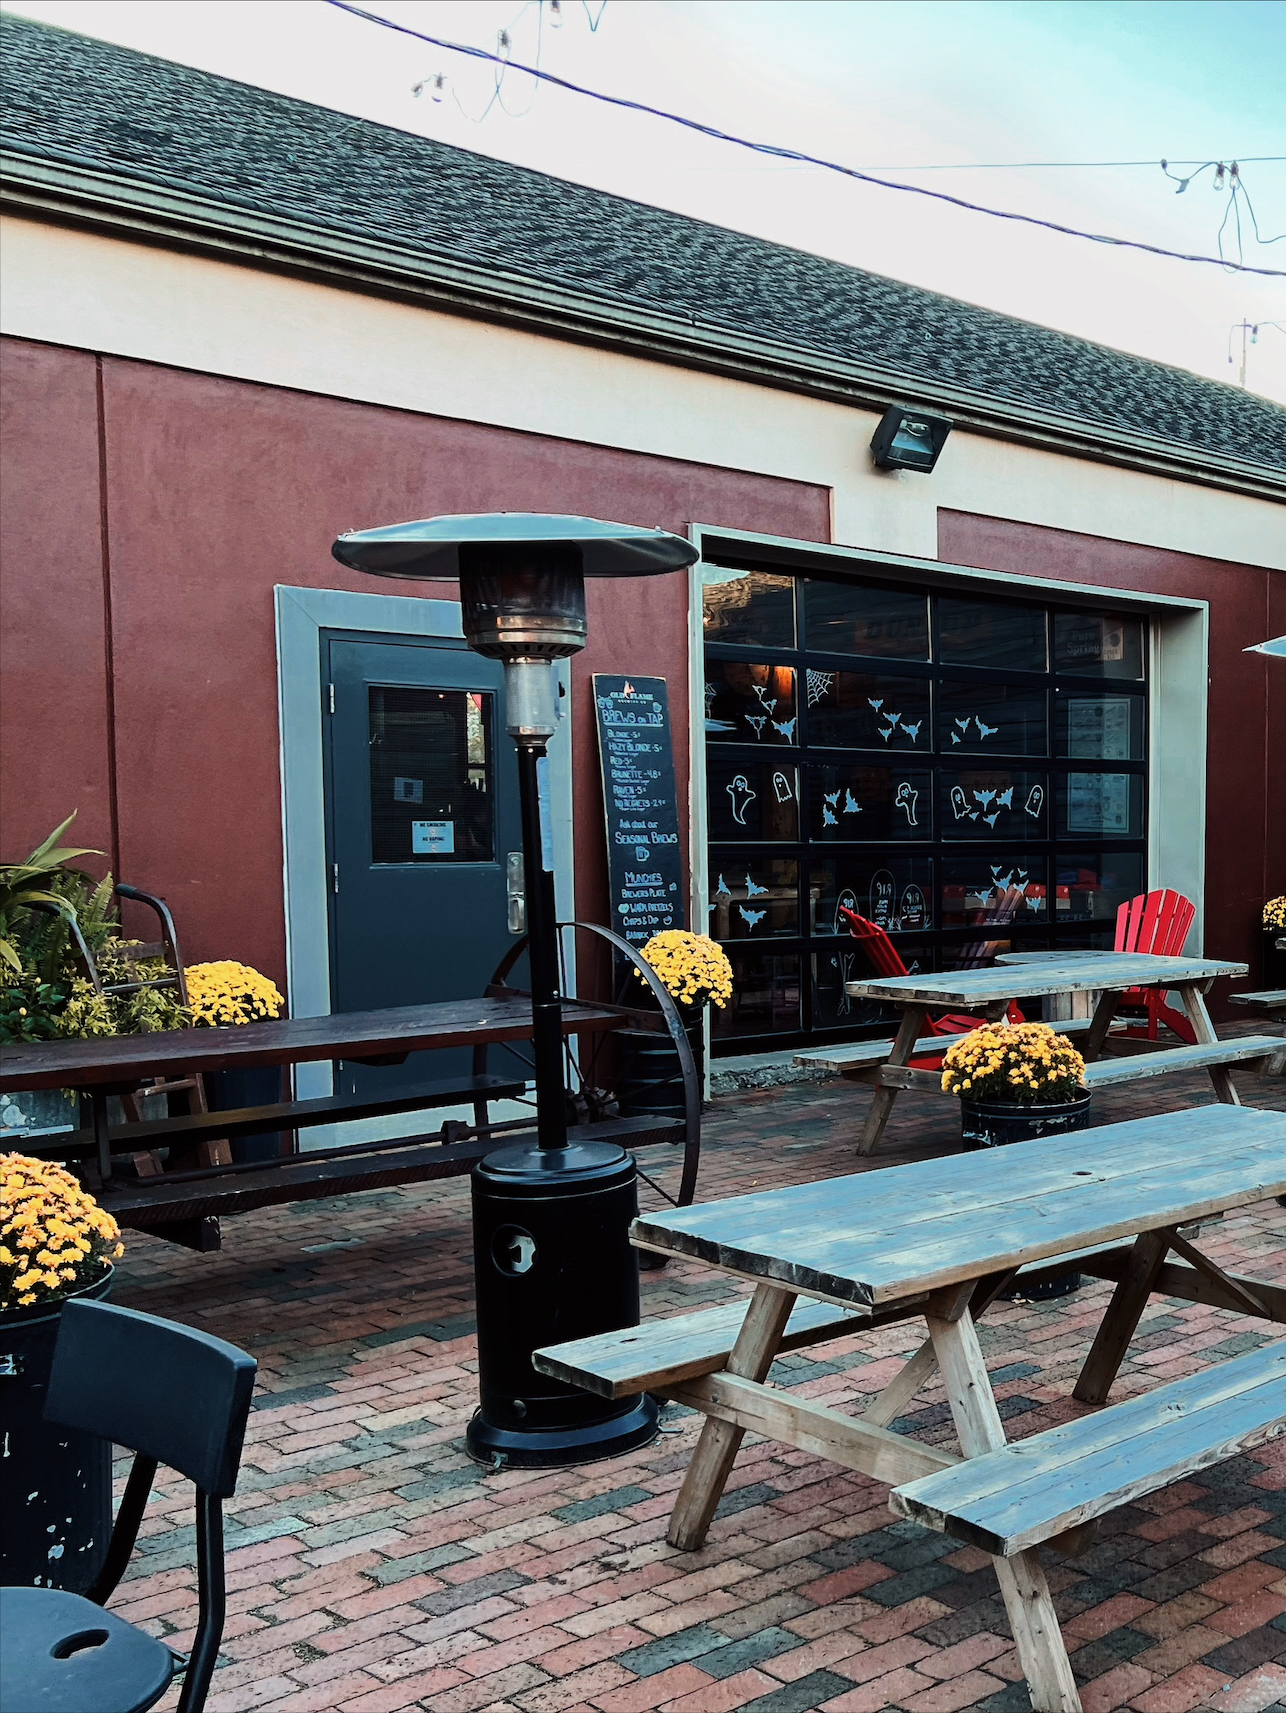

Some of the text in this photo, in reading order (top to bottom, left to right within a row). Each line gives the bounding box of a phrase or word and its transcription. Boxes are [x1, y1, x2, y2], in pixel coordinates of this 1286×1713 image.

[1066, 641, 1100, 656] Spring
[602, 710, 636, 723] BREWS
[646, 712, 664, 724] TAP
[611, 769, 642, 778] BRUNETTE
[615, 832, 678, 844] SEASONAL BREWS
[625, 872, 663, 883] MUNCHIES
